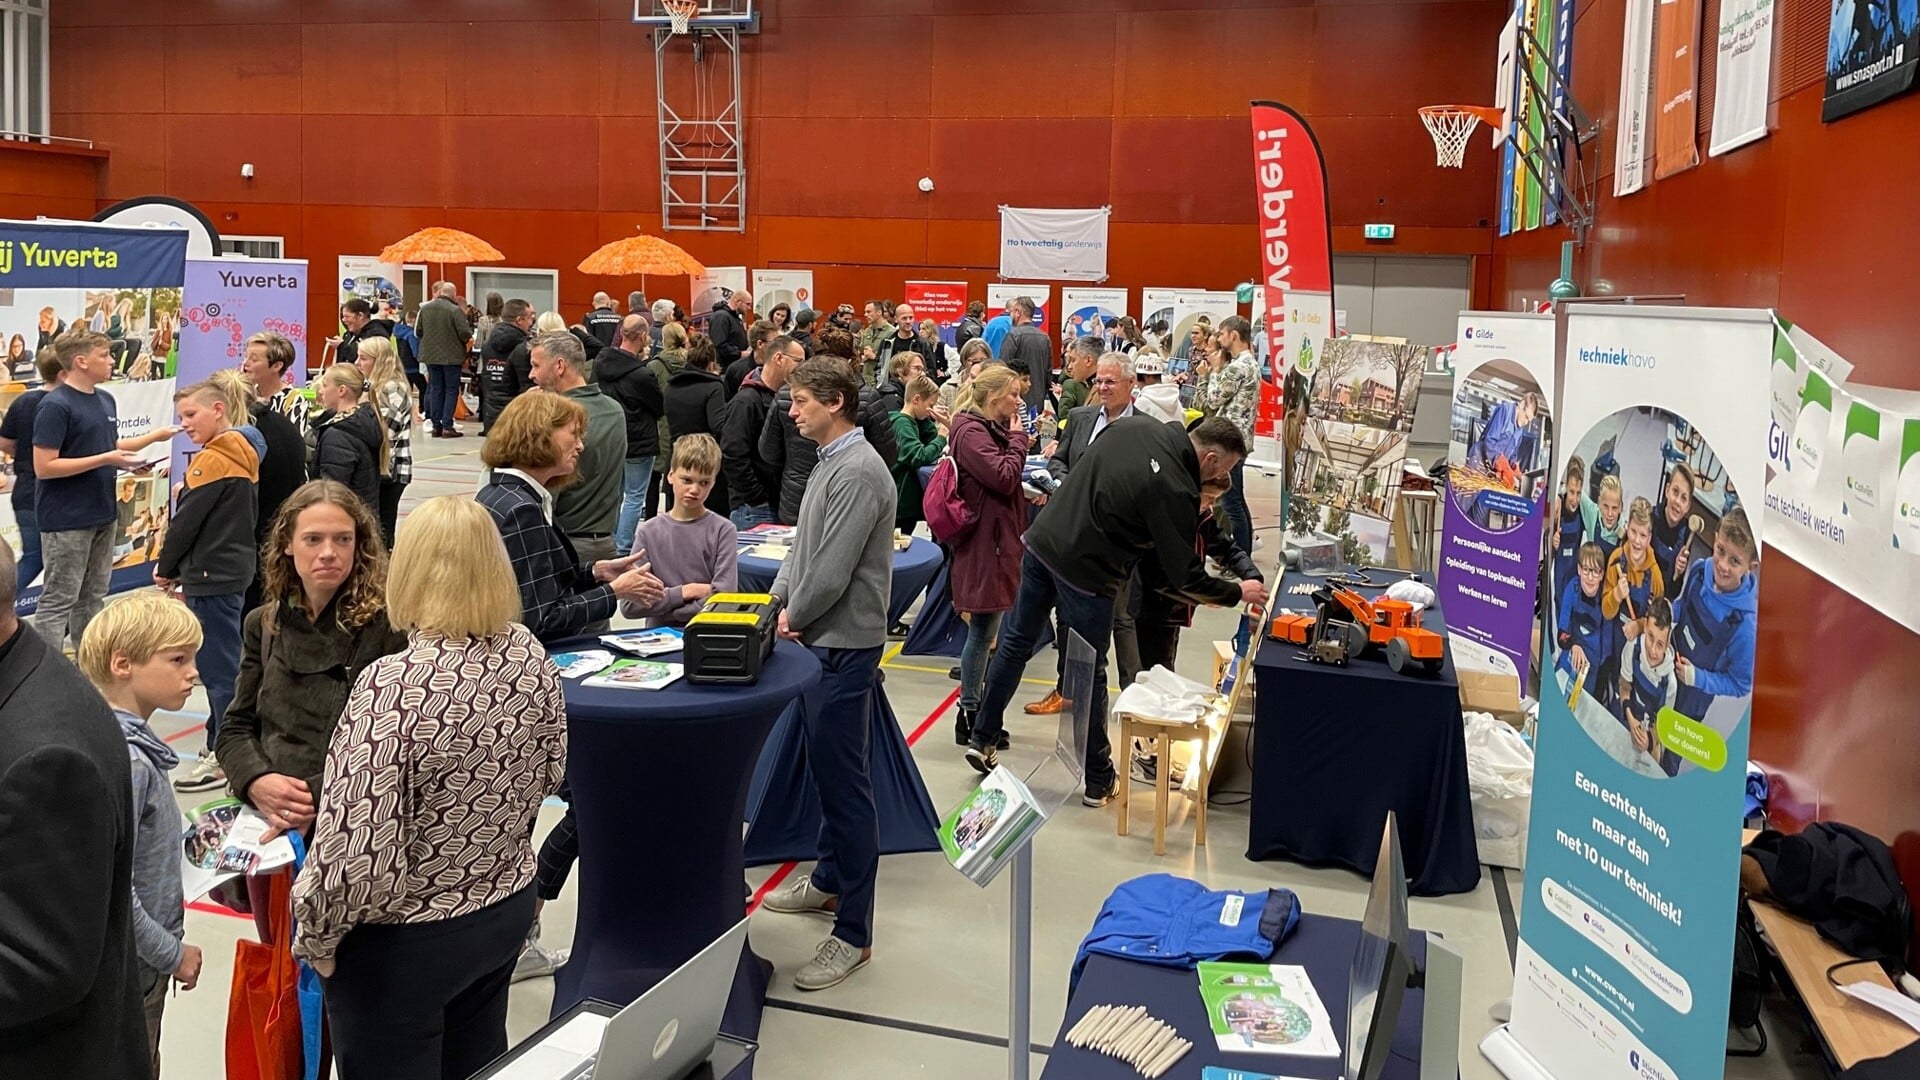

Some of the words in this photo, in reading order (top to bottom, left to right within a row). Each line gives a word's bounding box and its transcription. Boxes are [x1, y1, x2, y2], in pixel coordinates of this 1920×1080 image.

[1836, 49, 1895, 90] www.snasport.nl
[20, 242, 118, 269] Yuverta
[1021, 239, 1063, 249] tweetalig
[1064, 240, 1103, 249] onderwijs
[218, 271, 298, 289] Yuverta
[1780, 496, 1812, 529] techniek
[1813, 516, 1845, 545] werken
[1453, 535, 1491, 553] Persoonlijke
[1492, 548, 1521, 562] aandacht
[1446, 556, 1475, 574] Opleiding
[1476, 565, 1487, 576] van
[1487, 569, 1526, 589] topkwaliteit
[1458, 583, 1482, 599] Werken
[1482, 592, 1491, 602] en
[1491, 594, 1508, 608] leren
[1674, 720, 1686, 734] Een
[1686, 727, 1704, 743] havo
[1575, 770, 1599, 797] Een
[1601, 787, 1637, 820] echte
[1639, 807, 1670, 848] havo,
[1592, 816, 1627, 847] maar
[1627, 837, 1649, 866] dan
[1556, 828, 1582, 855] met
[1583, 842, 1598, 864] 10
[1600, 856, 1623, 880] uur
[1624, 868, 1682, 927] techniek!
